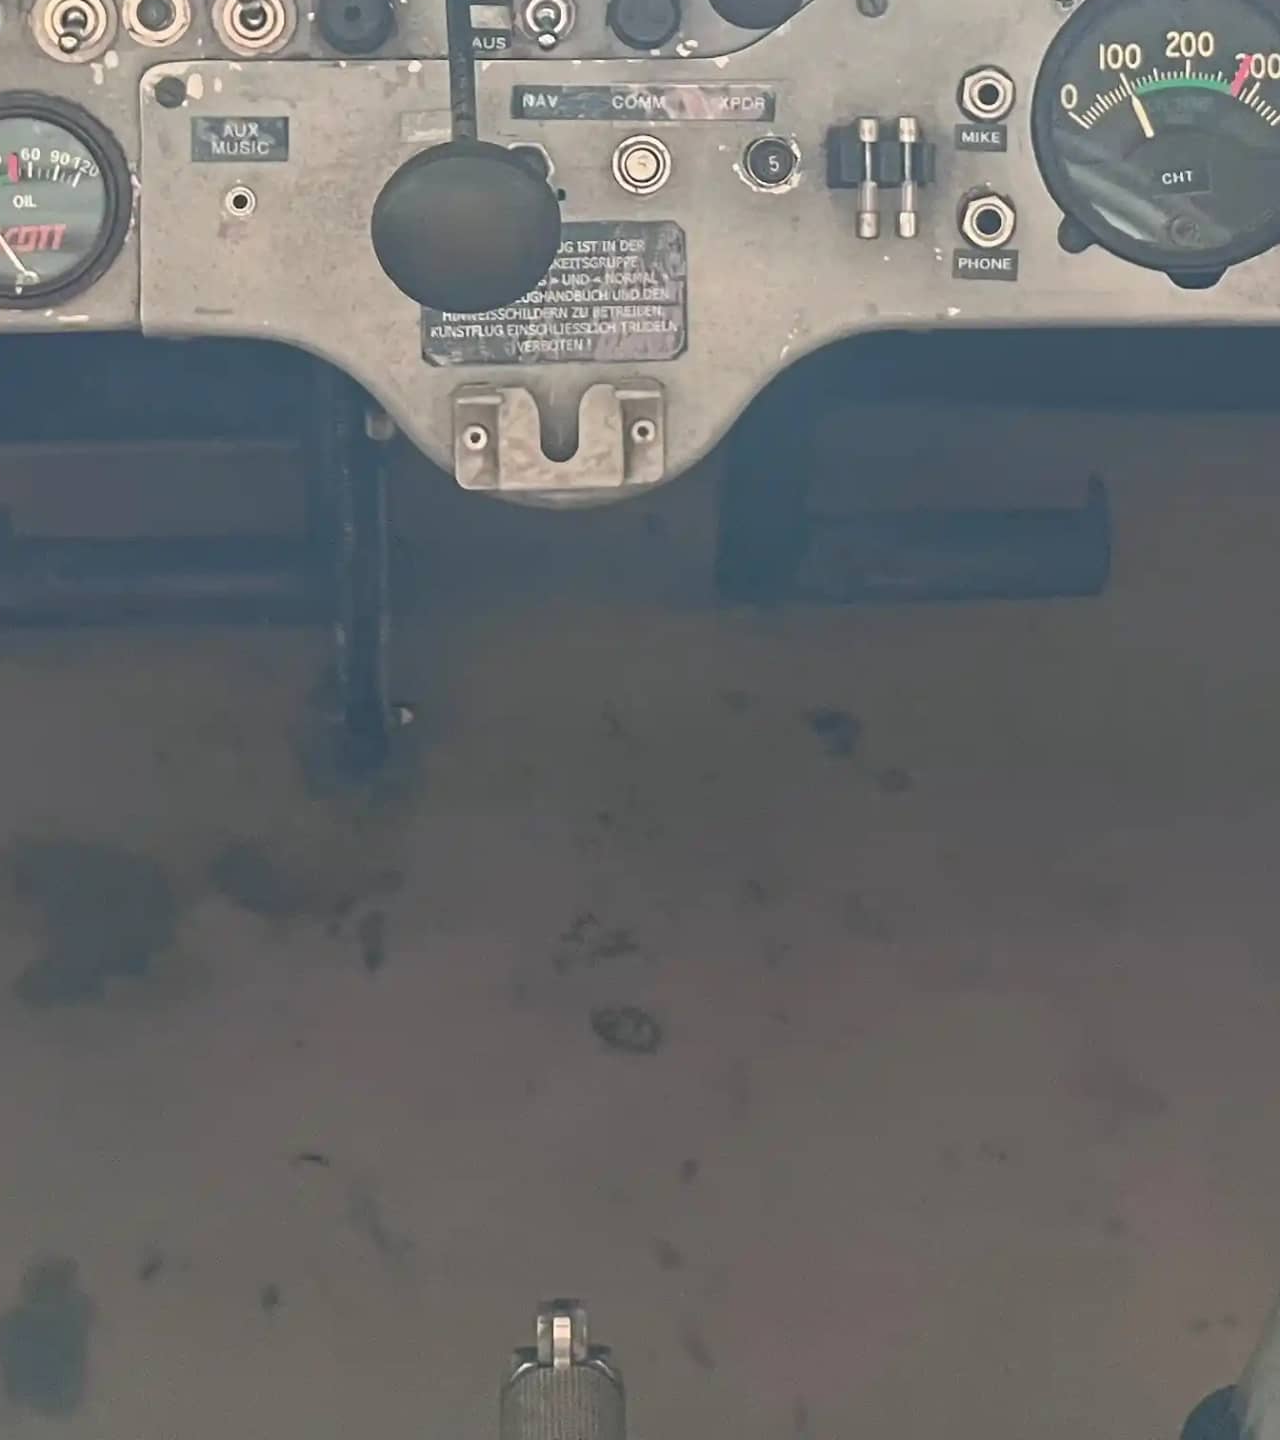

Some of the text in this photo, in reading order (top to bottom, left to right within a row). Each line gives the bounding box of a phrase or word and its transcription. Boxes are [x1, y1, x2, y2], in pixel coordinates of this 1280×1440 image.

[472, 37, 506, 49] AUS
[1165, 31, 1214, 58] 200
[1099, 43, 1142, 70] 100
[522, 94, 766, 109] NAV COMM XPDR
[1060, 84, 1078, 109] 0
[222, 123, 259, 138] AUX
[962, 131, 1001, 143] MIKE
[21, 147, 41, 161] 60
[211, 142, 270, 156] MUSIC
[50, 150, 69, 166] 90
[768, 155, 780, 172] 5
[72, 156, 100, 178] 120
[1162, 170, 1193, 185] CHT
[12, 195, 36, 209] OIL
[577, 241, 597, 252] IST
[602, 241, 616, 252] IN
[620, 240, 645, 252] DER
[958, 257, 1012, 270] PHONE
[561, 274, 658, 286] UND NORMAL
[571, 308, 588, 319] ZU
[430, 324, 504, 337] KUNSTFLUG
